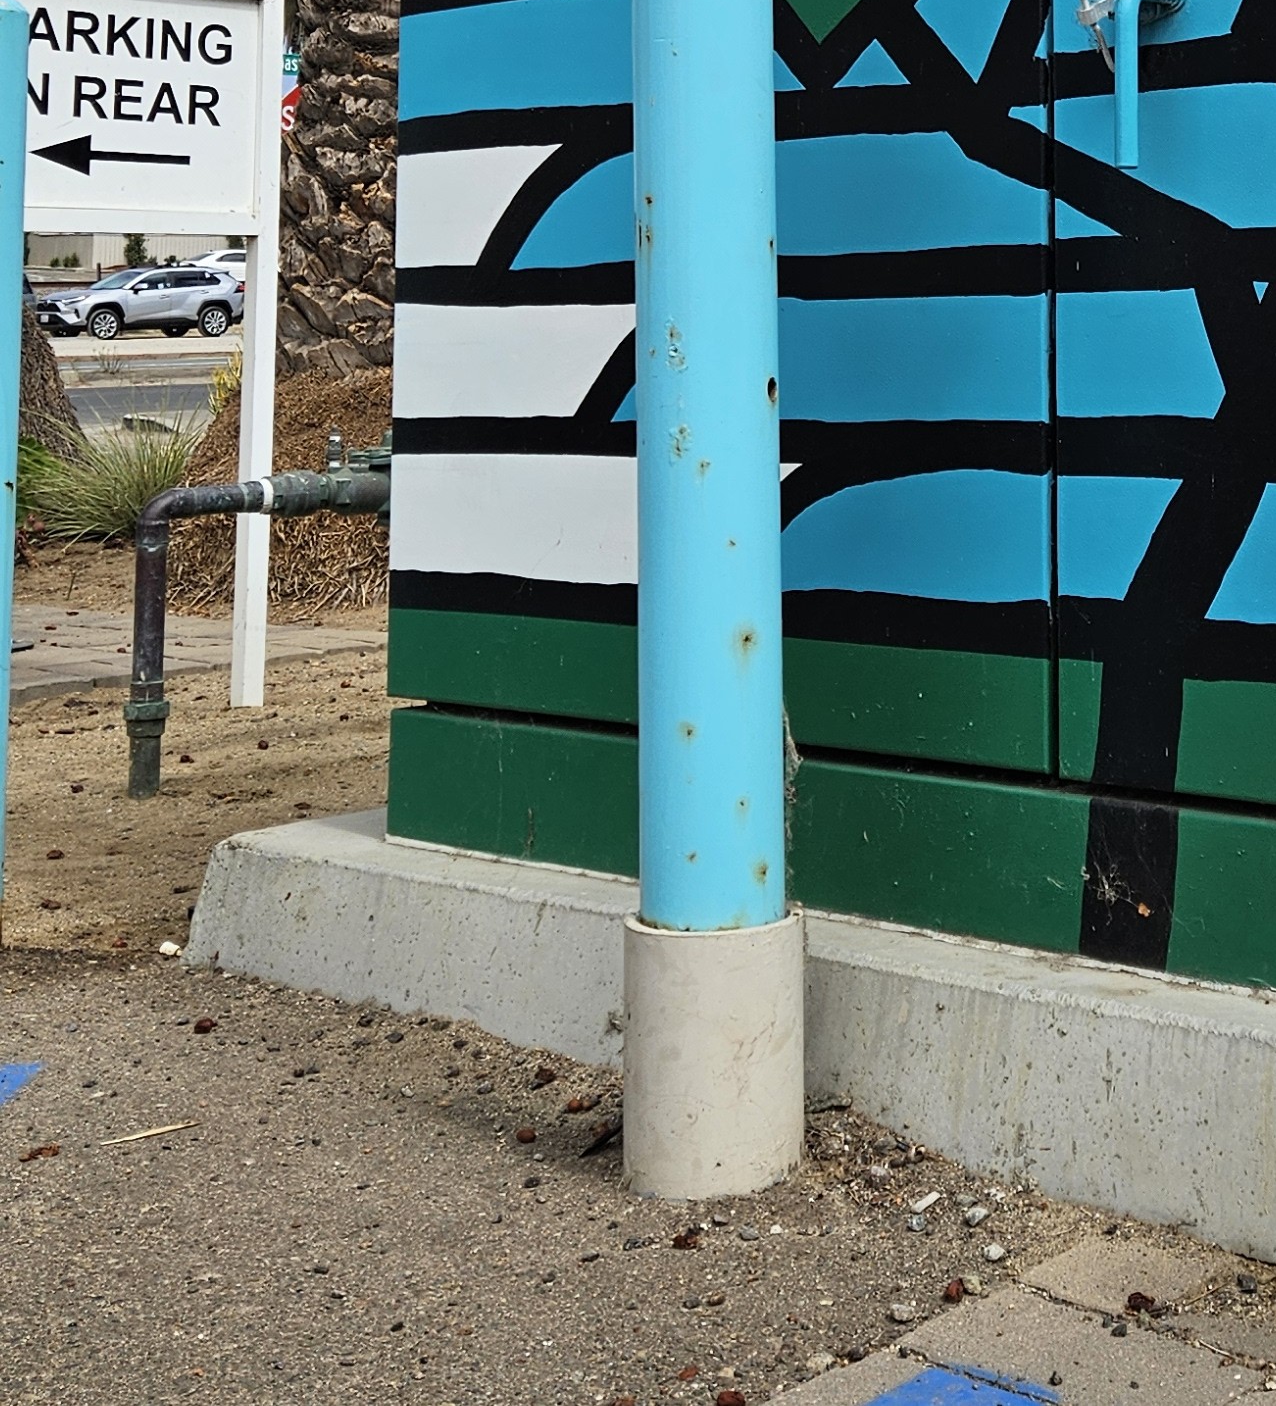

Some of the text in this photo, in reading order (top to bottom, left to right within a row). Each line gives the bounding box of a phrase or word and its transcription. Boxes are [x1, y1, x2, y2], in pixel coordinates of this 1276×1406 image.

[29, 6, 234, 66] ARKING
[28, 73, 221, 127] N REAR
